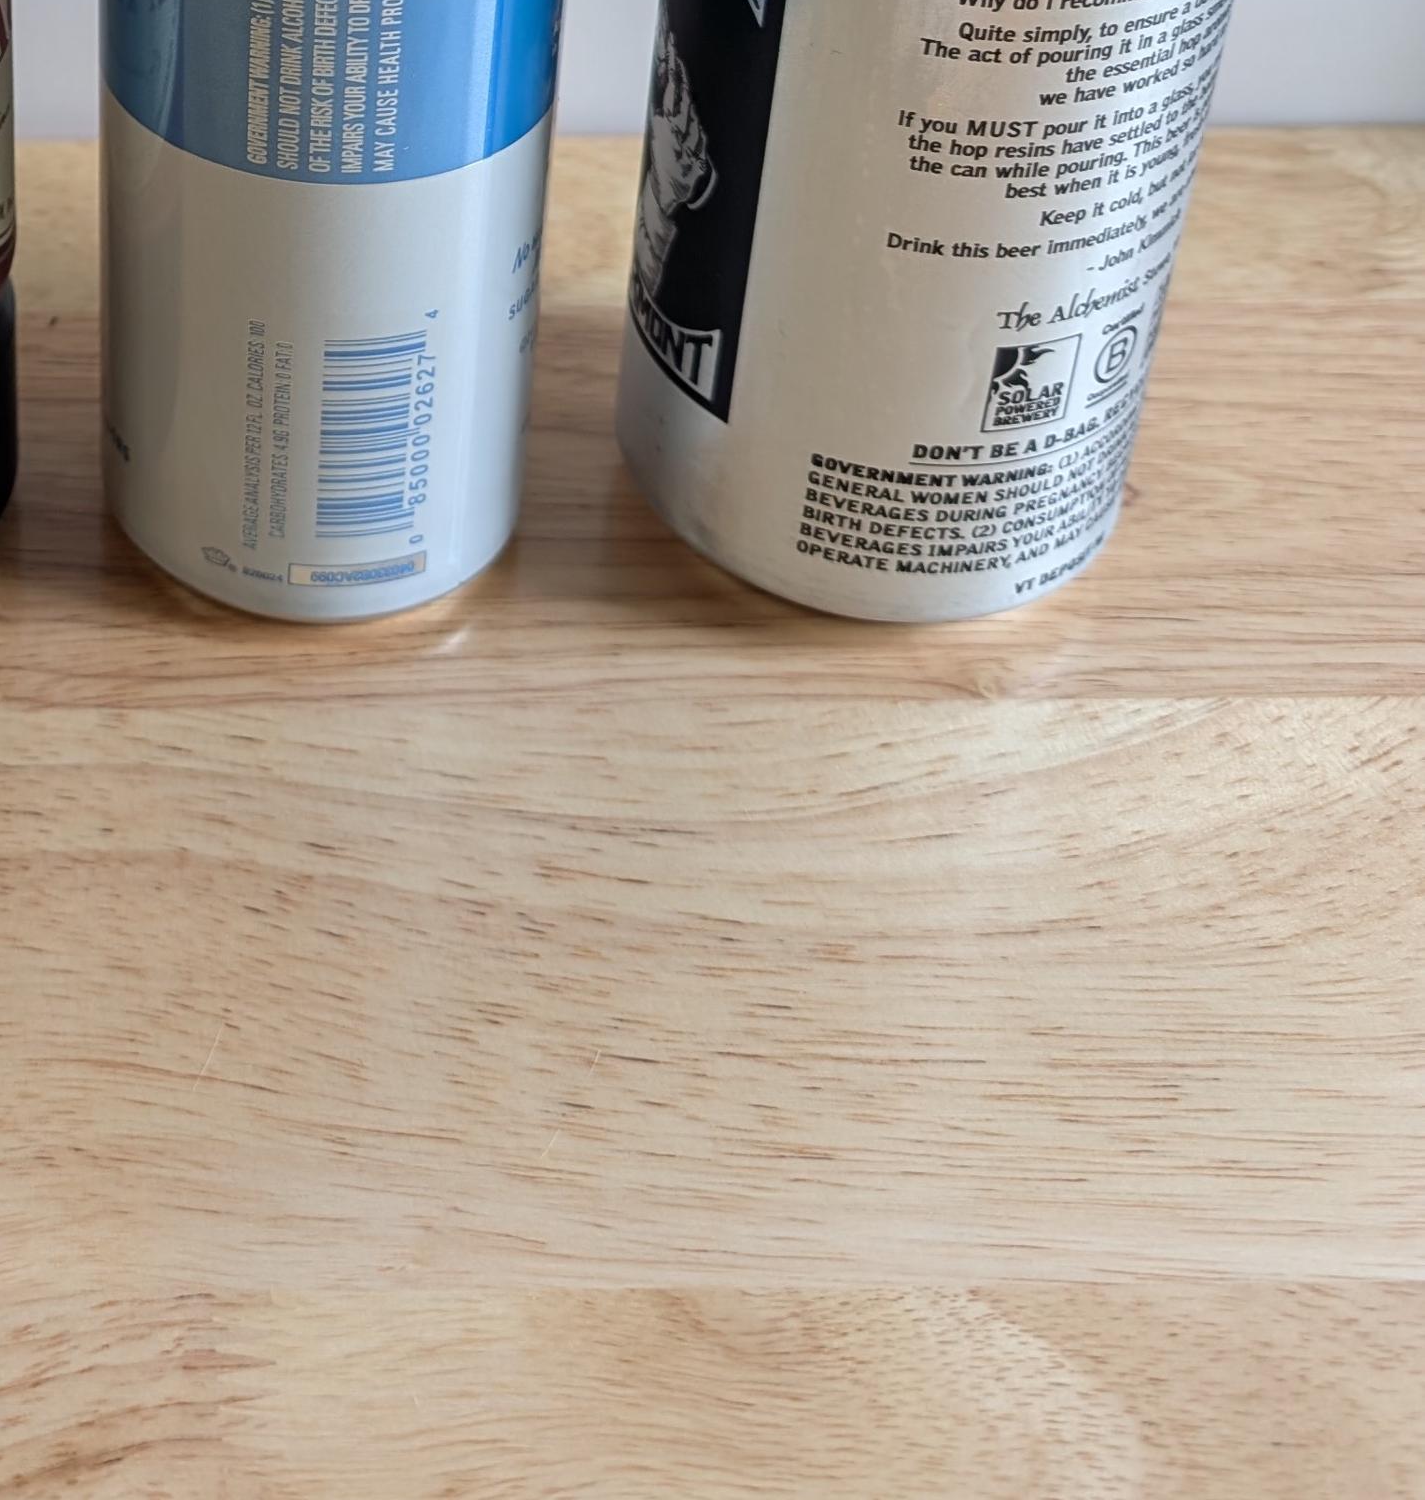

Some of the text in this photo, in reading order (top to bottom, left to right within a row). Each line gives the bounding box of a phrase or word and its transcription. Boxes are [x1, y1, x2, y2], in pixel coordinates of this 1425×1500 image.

[958, 7, 1178, 46] Quite simply, ensure
[280, 45, 303, 85] DRINK
[313, 39, 336, 77] BIRTH
[345, 36, 369, 86] ABILITY
[378, 30, 401, 85] HEALTH
[921, 38, 1112, 67] The act of pouring
[1066, 44, 1174, 83] the essential
[1039, 61, 1180, 105] we have worked
[344, 86, 366, 119] YOUR
[376, 89, 398, 136] CAUSE
[247, 83, 269, 165] GOVERNMENT
[909, 115, 1163, 160] the hop resins have settled
[920, 107, 1144, 140] you MUST pour into
[277, 114, 300, 170] SHOULD
[341, 118, 363, 173] IMPAIRS
[373, 143, 394, 172] MAY
[910, 152, 1128, 178] the can while pouring.
[1005, 176, 1101, 199] best when
[1039, 209, 1086, 227] Keep
[886, 232, 1041, 258] Drink this beer
[1098, 248, 1134, 271] John
[997, 301, 1041, 332] The
[995, 398, 1061, 416] POWERED
[998, 382, 1064, 406] SOLAR
[407, 355, 436, 505] 85000 02627
[992, 406, 1059, 426] BREWERY
[912, 442, 1019, 460] DON'T BE
[811, 453, 1053, 487] GOVERNMENT WARNING:
[805, 487, 1007, 523] BEVERAGES DURING
[808, 471, 1064, 505] GENERAL WOMEN SHOULD
[802, 505, 965, 539] BIRTH DEFECTS.
[796, 539, 1050, 574] OPERATE MACHINERY, AND
[800, 522, 1055, 557] BEVERAGES IMPAIRS YOUR
